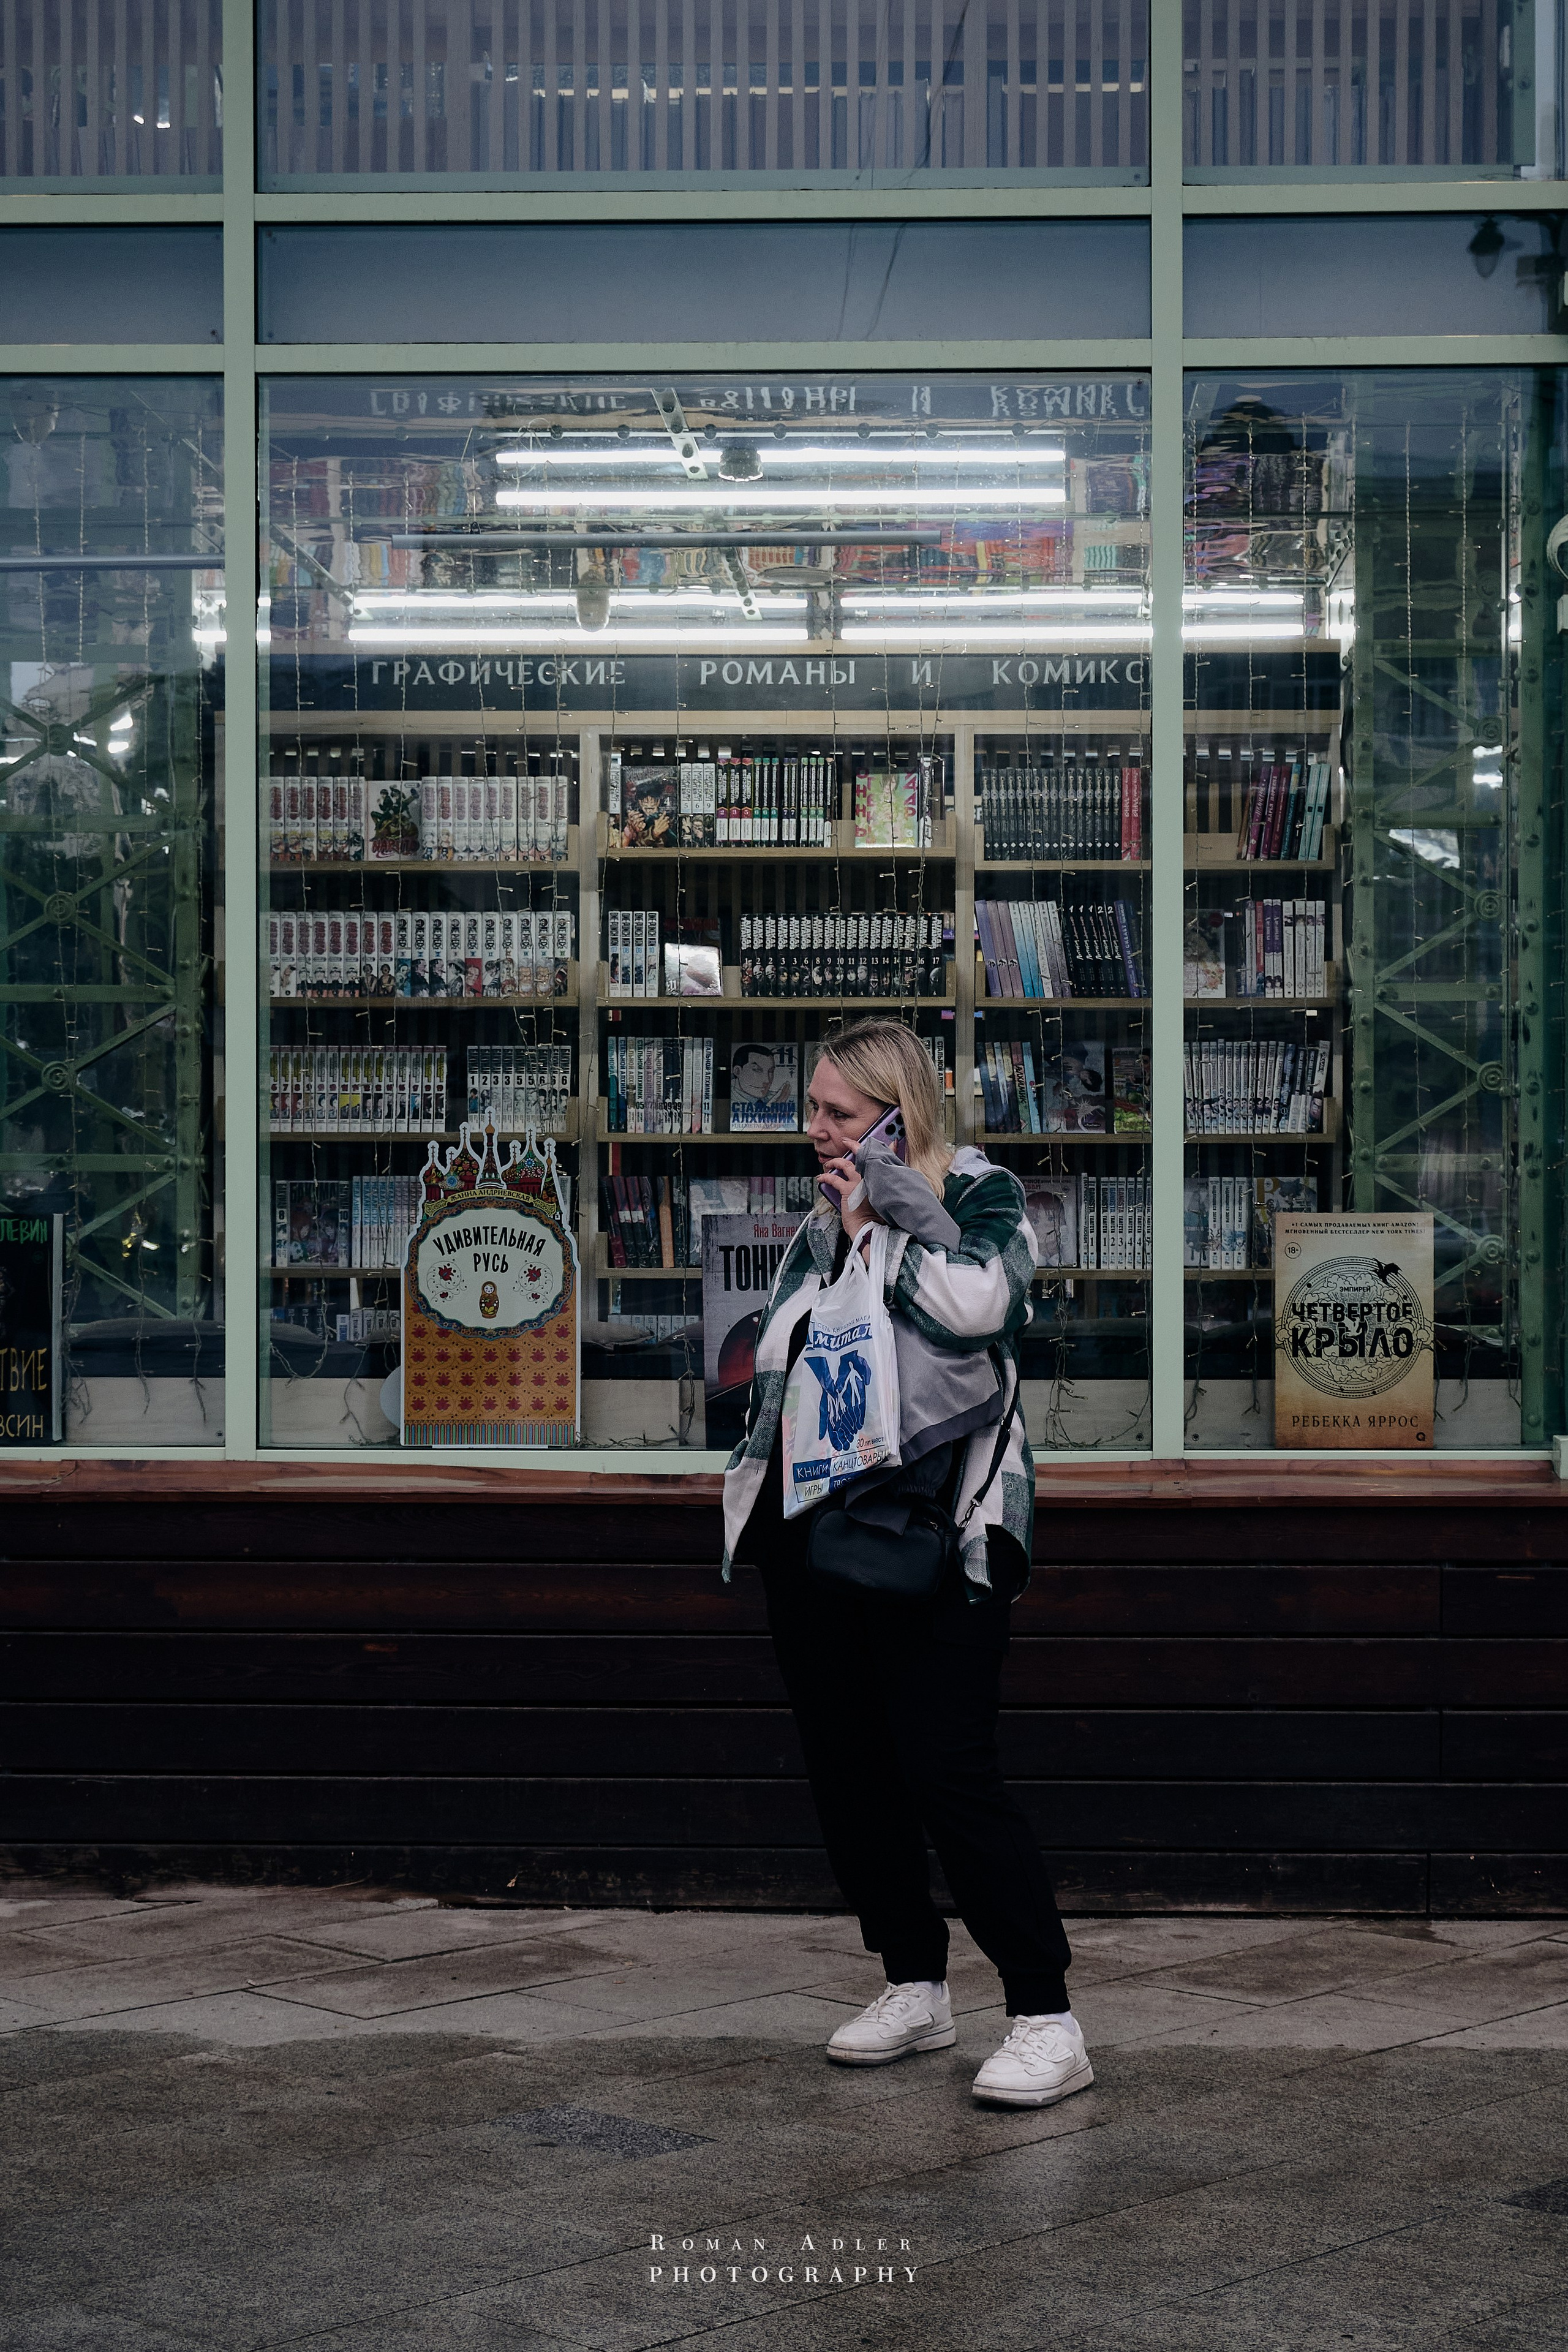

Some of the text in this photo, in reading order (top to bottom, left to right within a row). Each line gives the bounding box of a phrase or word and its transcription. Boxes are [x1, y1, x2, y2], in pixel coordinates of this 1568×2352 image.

[371, 660, 1144, 685] ГРАФИЧЕСКИЕ РОМАНЫ И КОМИКС
[663, 796, 670, 806] 4
[1069, 905, 1075, 914] 1
[1088, 905, 1095, 914] 1
[1097, 905, 1104, 914] 2
[777, 1047, 794, 1064] 11
[471, 1076, 475, 1085] 1
[483, 1076, 488, 1085] 2
[494, 1076, 499, 1085] 3
[517, 1076, 522, 1085] 5
[562, 1076, 567, 1085] 6
[1016, 1065, 1027, 1103] АЛХИМИК
[732, 1101, 796, 1113] СТАЛЬНОЙ
[732, 1113, 796, 1123] АЛХИМИК
[451, 1190, 531, 1201] ЖАННА АНДРИЕВСКАЯ
[341, 1211, 349, 1220] 10
[754, 1224, 769, 1237] Яна
[432, 1226, 546, 1256] УДИВИТЕЛЬНАЯ
[1090, 1237, 1094, 1246] 1
[1103, 1237, 1107, 1246] 1
[1110, 1237, 1115, 1246] 2
[1118, 1237, 1123, 1246] 3
[1128, 1237, 1133, 1246] 4
[473, 1253, 509, 1273] РУСЬ
[718, 1245, 790, 1291] ТОНН
[1292, 1302, 1414, 1322] ЧЕТВЕРТОЕ
[817, 1322, 831, 1333] СЕТЬ
[1292, 1322, 1414, 1359] КРЫЛО
[1292, 1415, 1419, 1428] РЕБЕККА ЯРРОС
[856, 1438, 864, 1449] 30
[833, 1450, 886, 1472] КАНЦТОВАРЫ
[797, 1464, 829, 1479] КНИГИ
[805, 1483, 823, 1497] ИГРЫ
